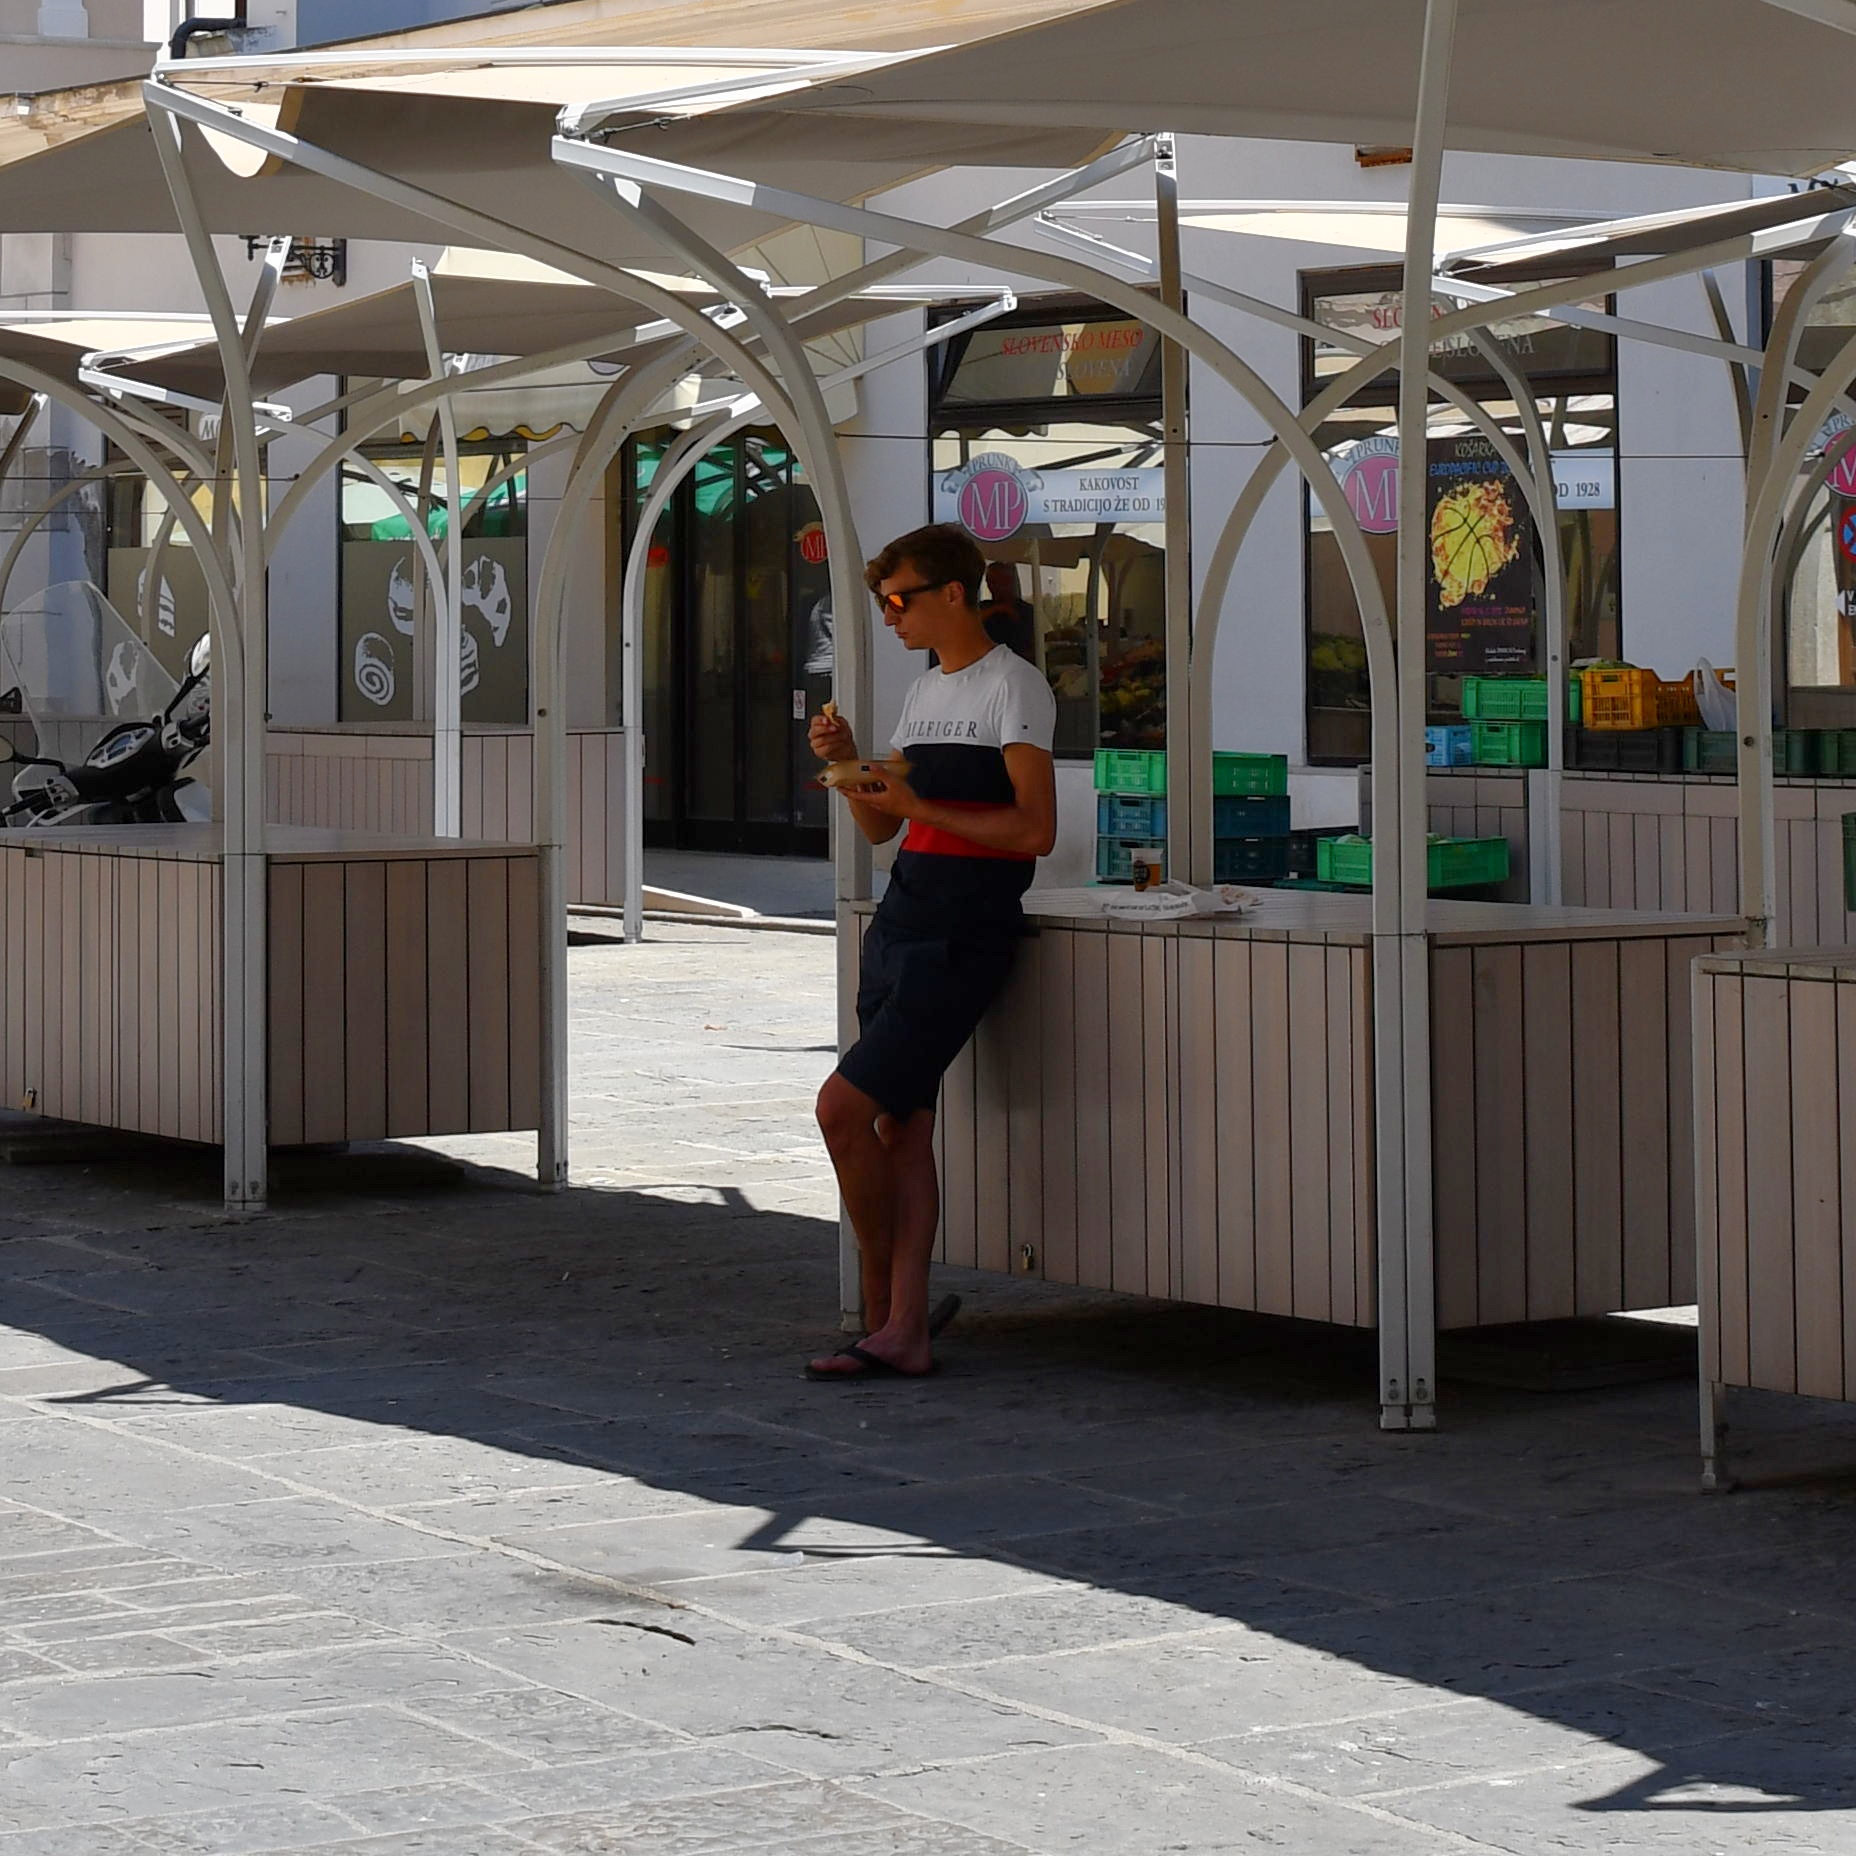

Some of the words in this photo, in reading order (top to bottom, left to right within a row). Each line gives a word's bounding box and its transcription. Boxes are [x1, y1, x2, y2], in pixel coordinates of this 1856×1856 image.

[972, 453, 1013, 474] PRUNK
[1079, 476, 1140, 492] KAKOVOST
[1576, 482, 1601, 498] 1928
[970, 480, 1022, 530] MP
[1044, 501, 1050, 513] S
[1053, 498, 1112, 516] TRADICIJO
[1114, 495, 1130, 512] ŽE
[1133, 497, 1151, 512] OD
